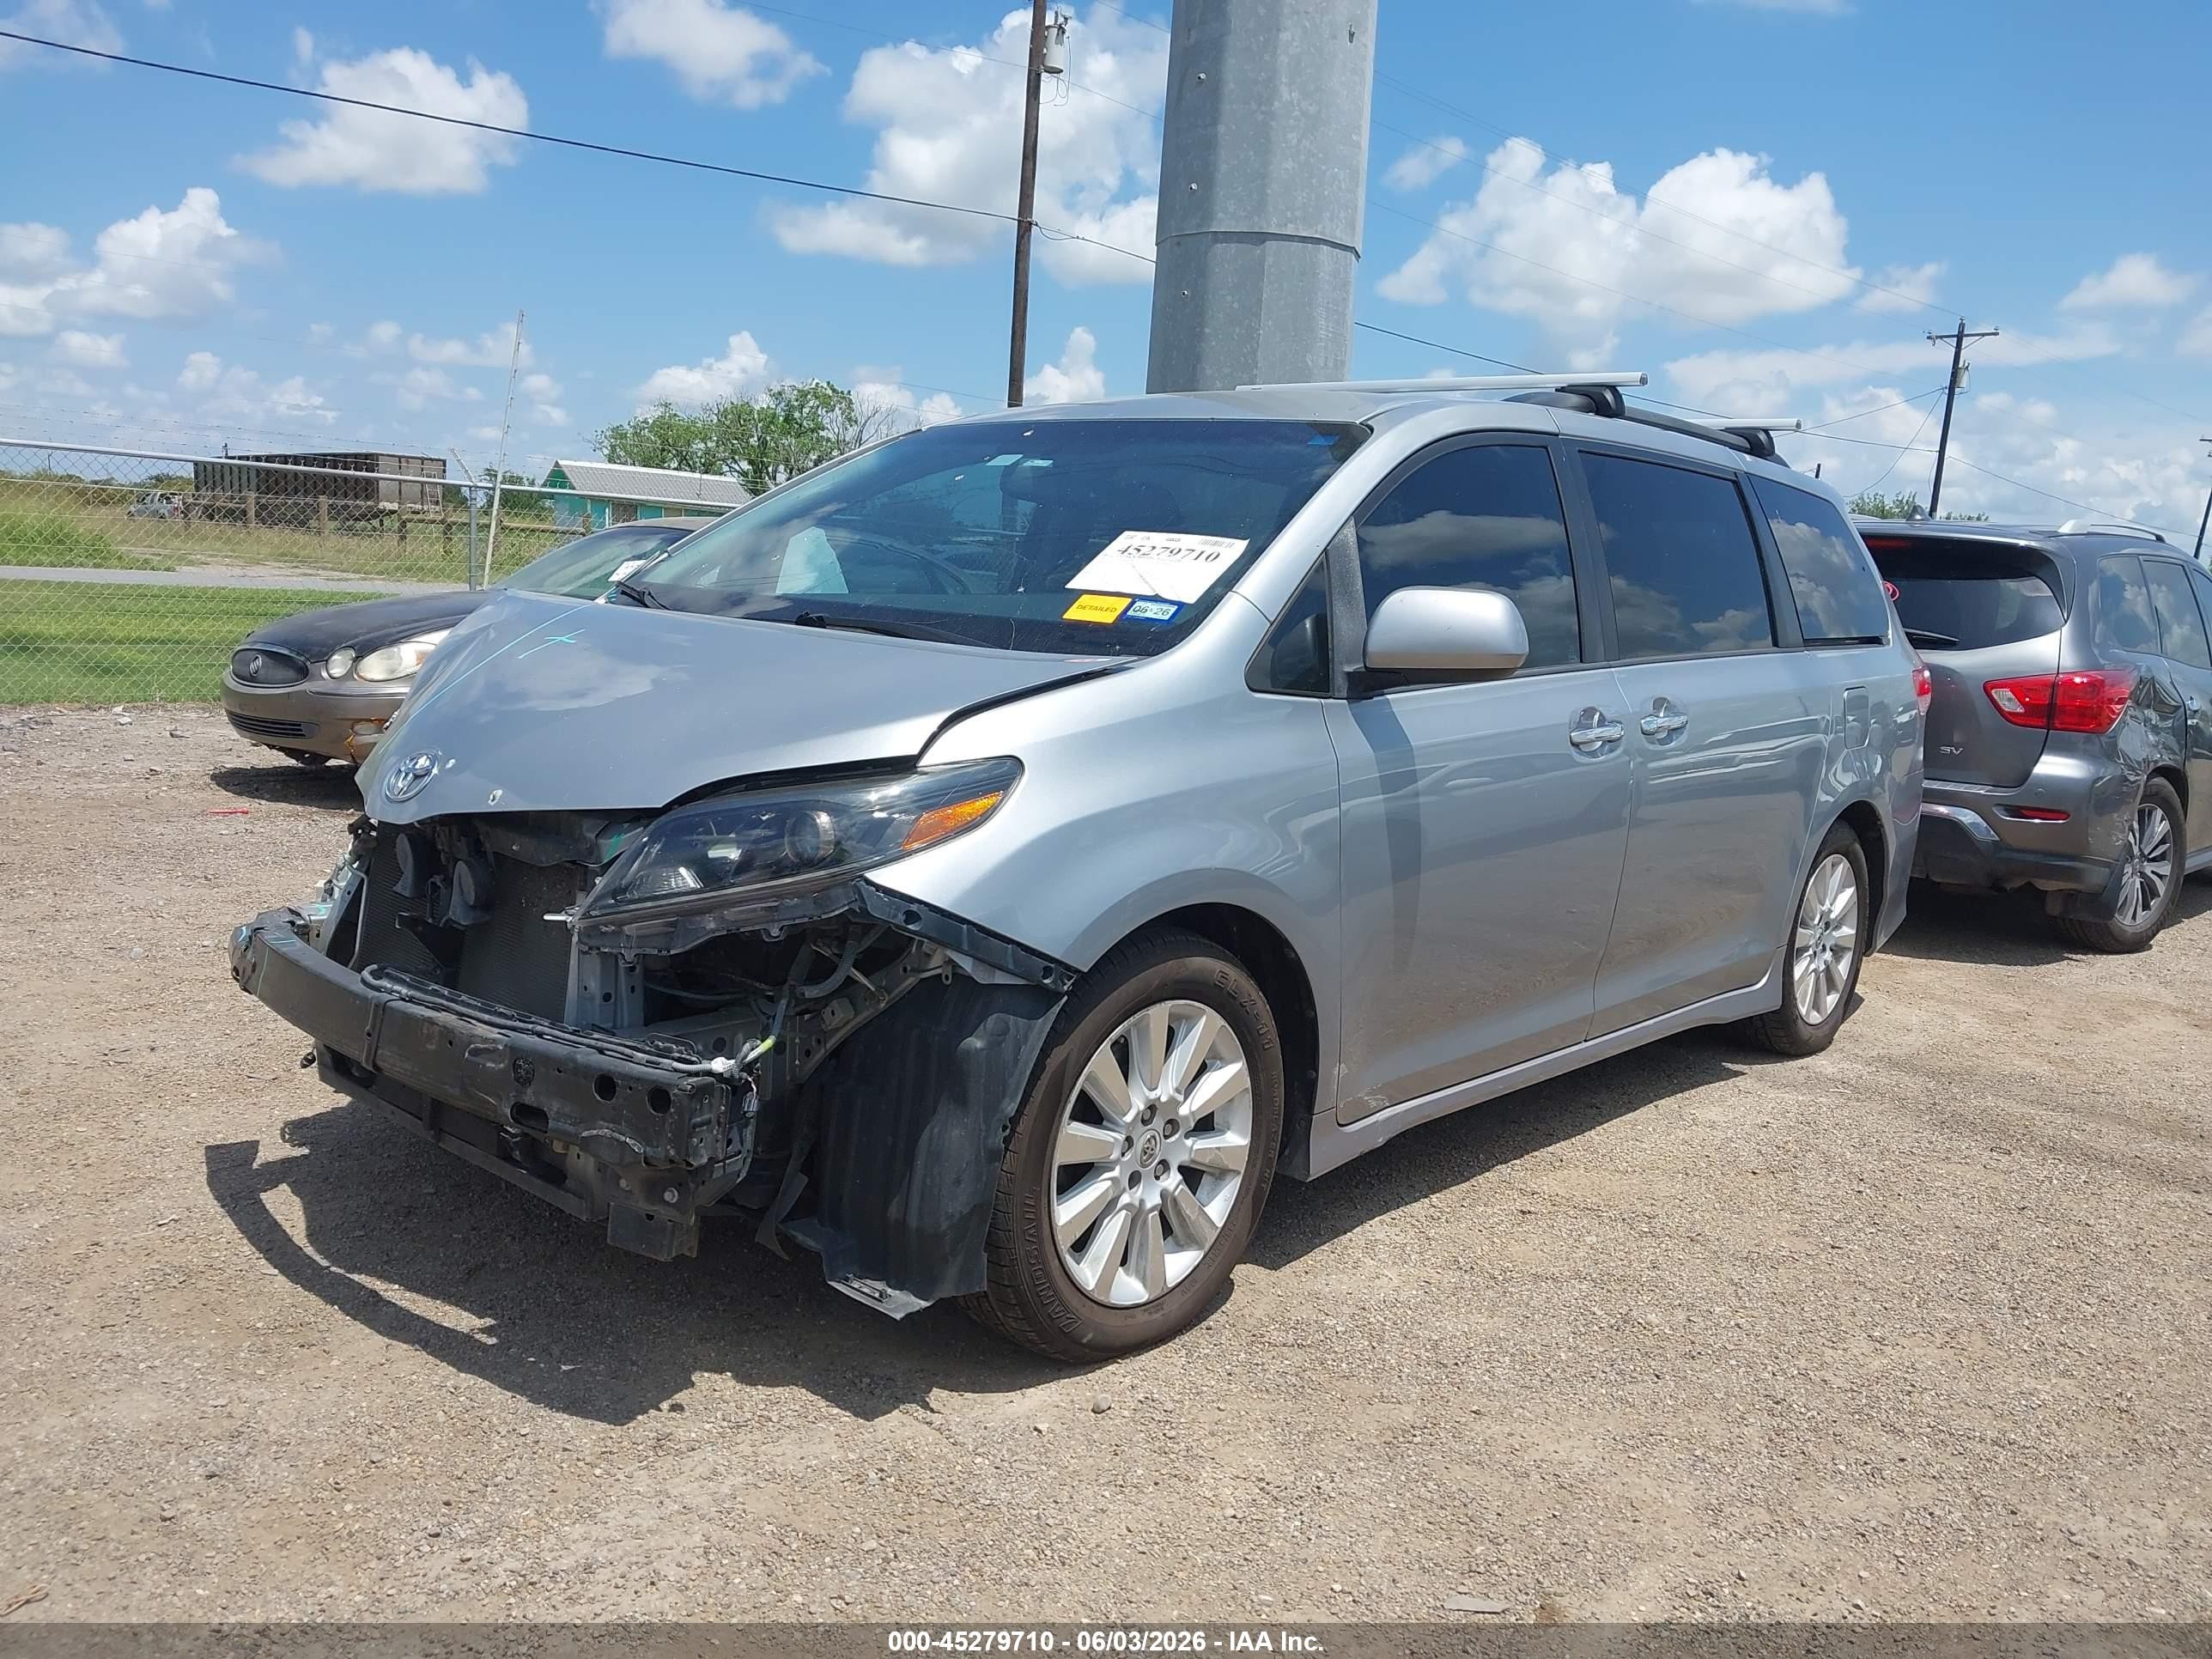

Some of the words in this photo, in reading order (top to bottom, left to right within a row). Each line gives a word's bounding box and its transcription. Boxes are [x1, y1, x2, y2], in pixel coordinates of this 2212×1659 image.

[1116, 544, 1221, 563] 45279710
[1075, 604, 1118, 613] DETAILED
[1153, 607, 1172, 617] 26
[1938, 745, 1965, 755] SV
[1022, 1191, 1085, 1334] LANDSAIL
